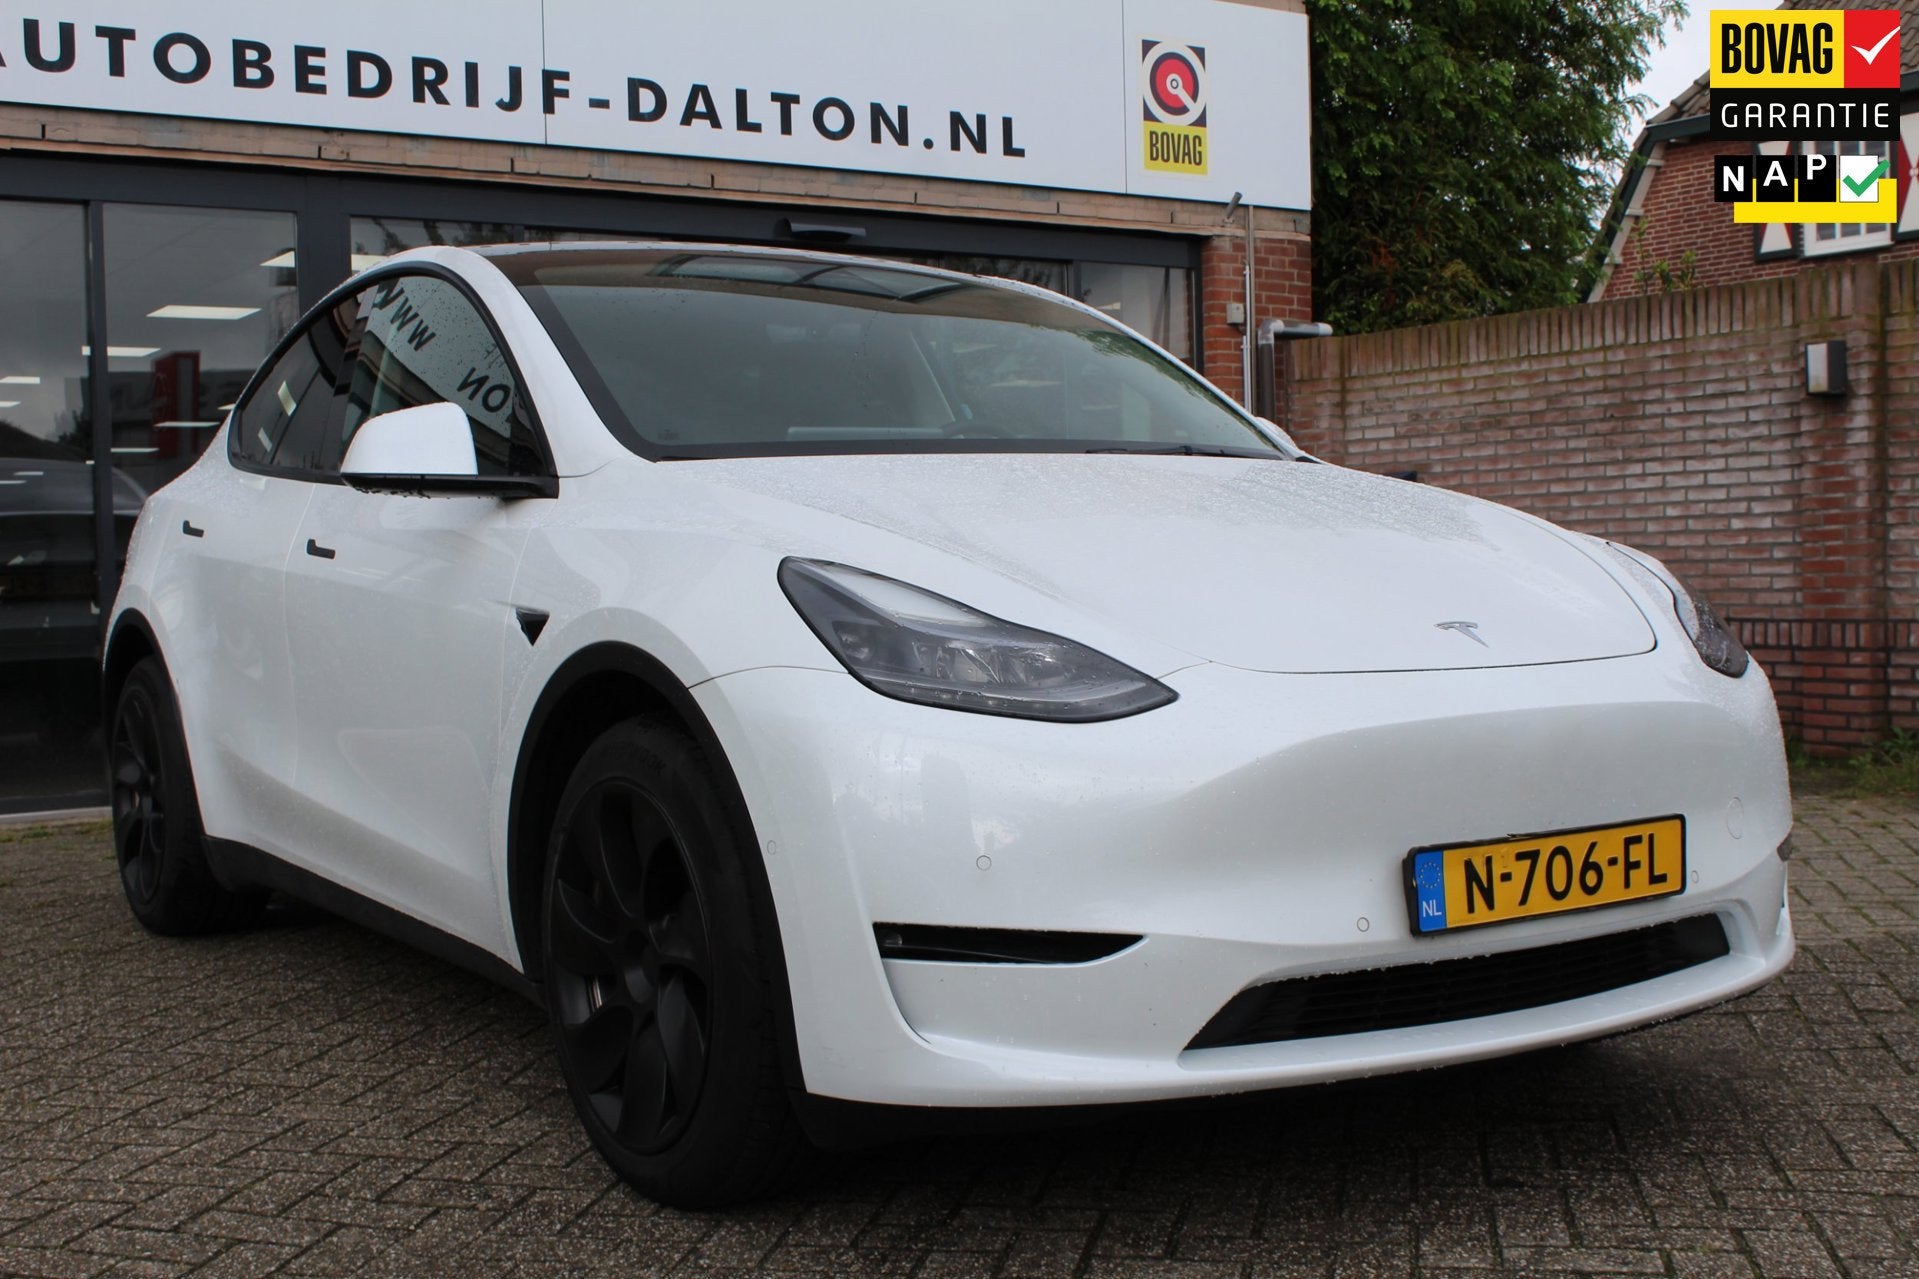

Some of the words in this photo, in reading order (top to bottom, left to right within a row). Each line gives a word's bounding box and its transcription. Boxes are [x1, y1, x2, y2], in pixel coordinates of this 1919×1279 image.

[0, 18, 1026, 158] UTOBEDRIJF-DALTON.NL
[1150, 130, 1203, 166] BOVAG
[1422, 899, 1442, 918] NL
[1464, 832, 1668, 914] N-706-FL
